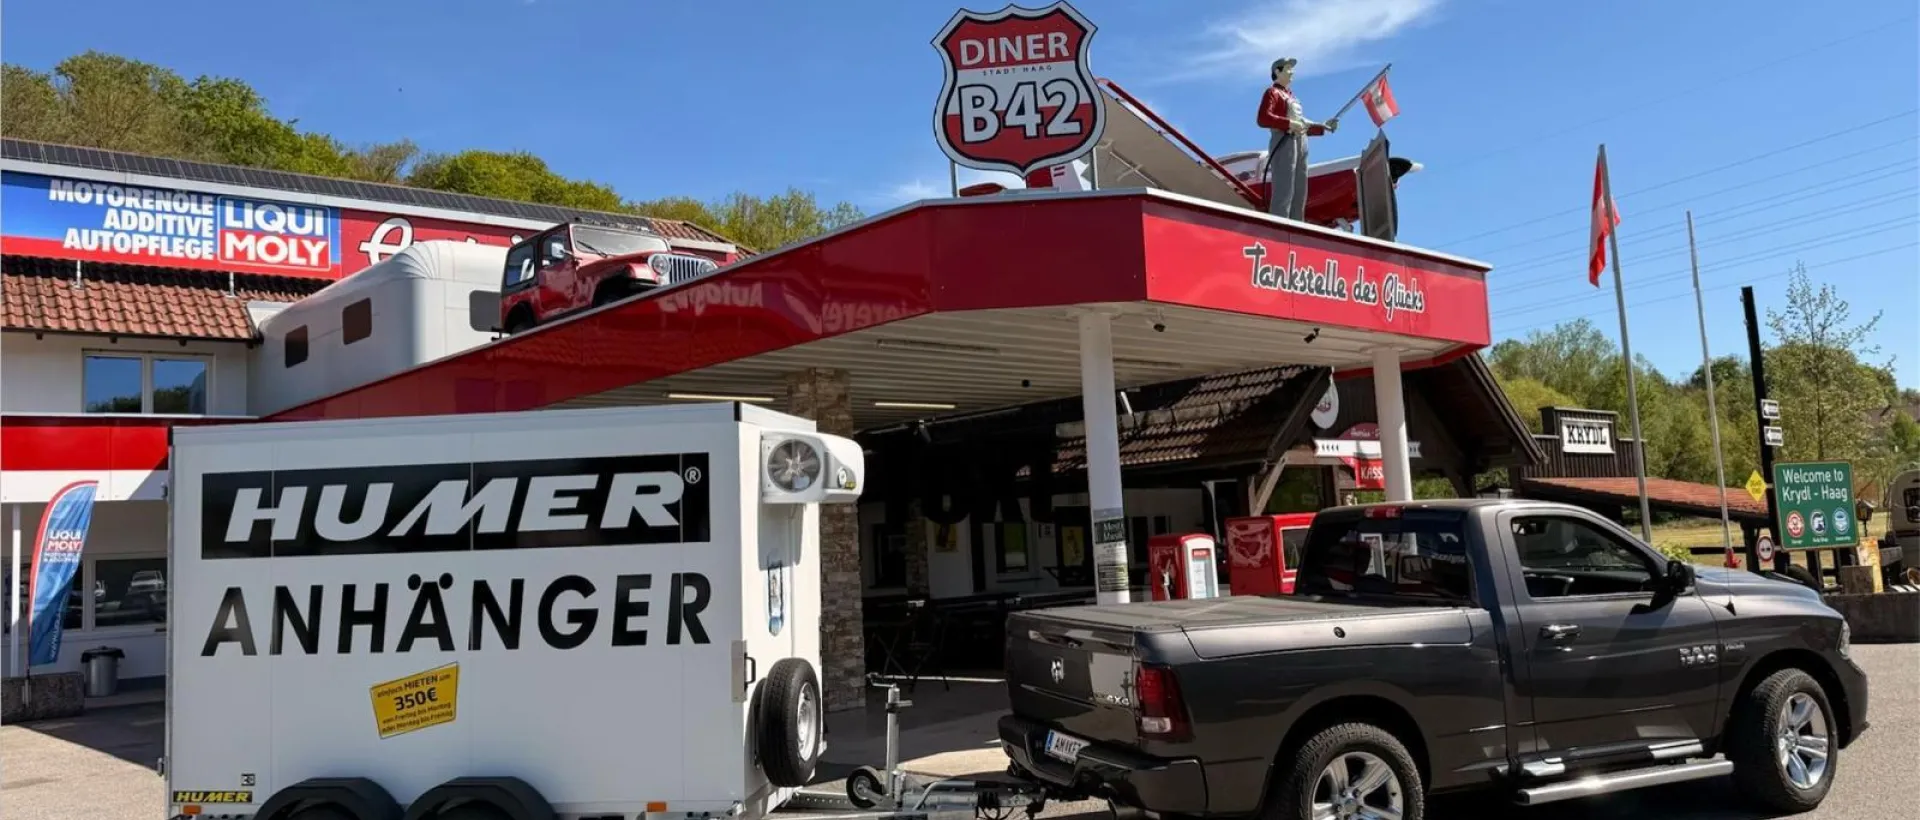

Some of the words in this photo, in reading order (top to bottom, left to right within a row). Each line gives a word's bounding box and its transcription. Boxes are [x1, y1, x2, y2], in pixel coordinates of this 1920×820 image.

[960, 31, 1069, 66] DINER
[983, 67, 1016, 76] STADT
[1023, 64, 1052, 73] HAAG
[957, 78, 1083, 144] B42
[49, 178, 214, 215] MOTORENÖLE
[104, 208, 214, 238] ADDITIVE
[225, 200, 324, 236] LIQUI
[63, 228, 214, 260] AUTOPFLEGE
[225, 232, 328, 266] MOLY
[1243, 242, 1348, 301] Tankstelle
[1353, 265, 1378, 305] des
[1383, 272, 1424, 321] Glücks
[1566, 424, 1607, 445] KRYDL
[1360, 465, 1384, 480] KASS
[1782, 468, 1831, 484] Welcome
[1833, 468, 1844, 482] to
[1782, 485, 1811, 505] Krydl
[1821, 484, 1848, 502] Haag
[48, 540, 82, 550] MOLY
[49, 530, 80, 539] LIQUI
[201, 571, 712, 657] ANHÄNGER
[404, 674, 438, 690] MIETEN
[393, 687, 438, 711] 350€
[176, 792, 249, 802] HUMER
